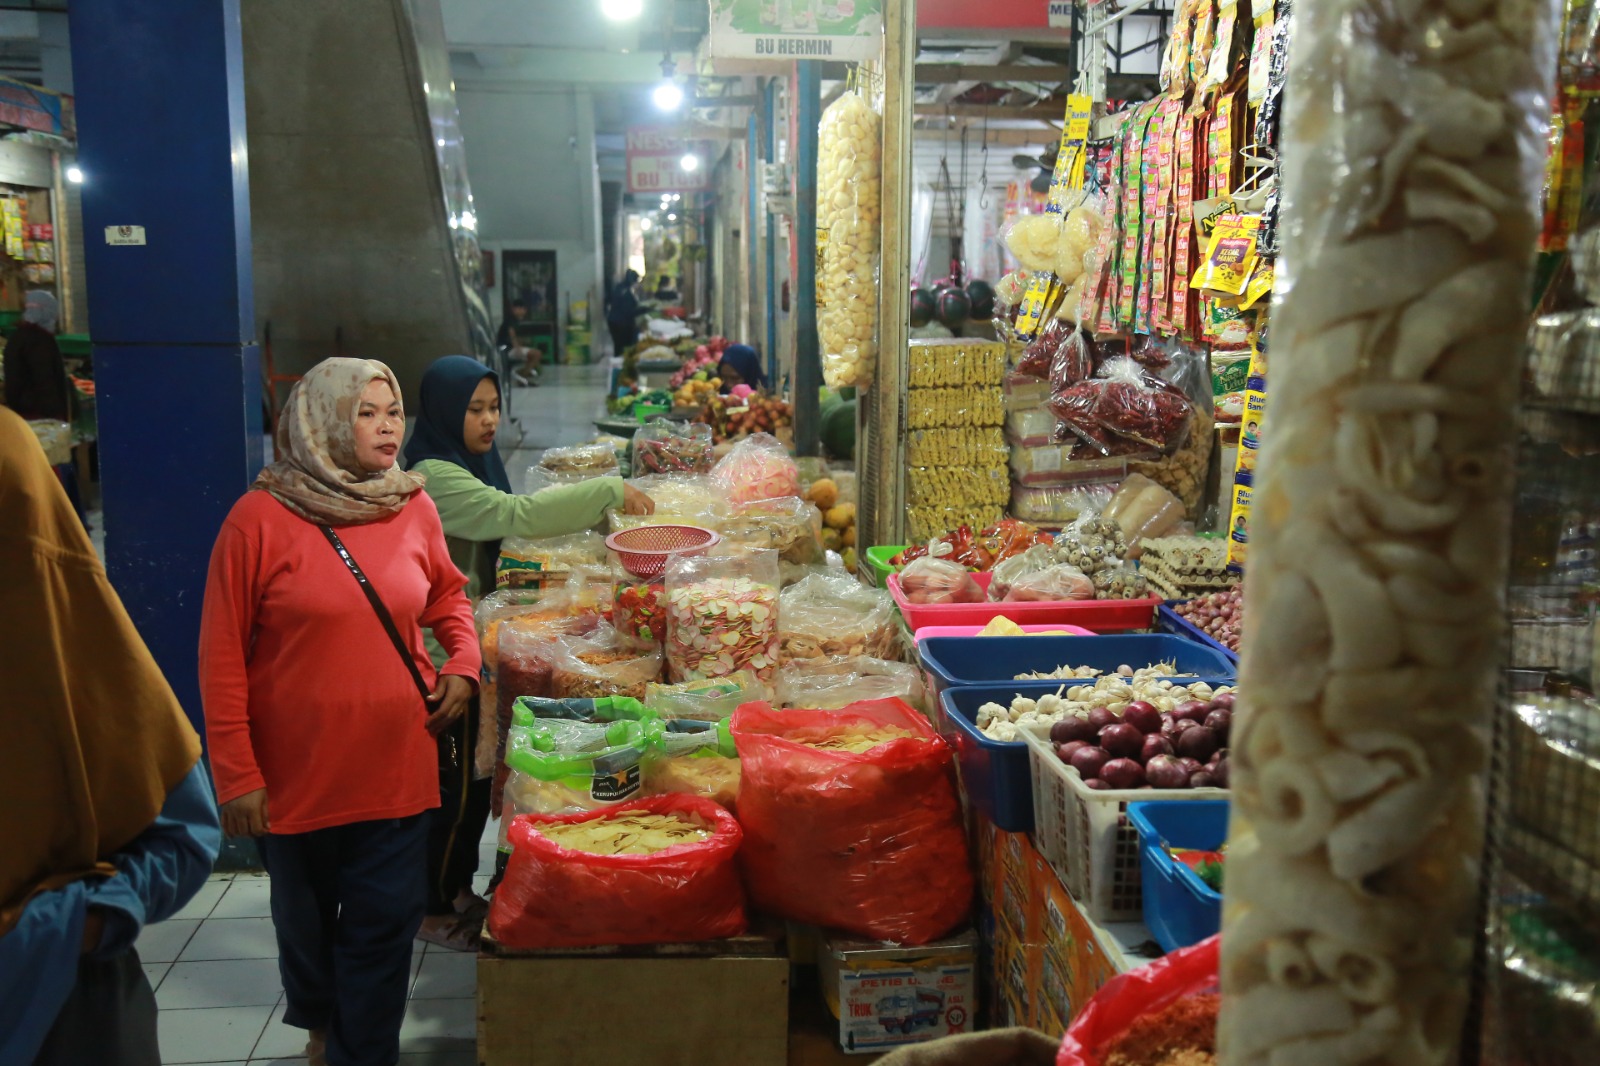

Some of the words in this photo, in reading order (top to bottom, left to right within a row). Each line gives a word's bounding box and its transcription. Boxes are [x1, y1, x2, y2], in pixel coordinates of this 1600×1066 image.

[755, 38, 774, 55] BU
[778, 39, 833, 56] HERMIN
[637, 172, 659, 187] BU
[1247, 403, 1265, 412] Ban
[1236, 497, 1253, 506] Ban
[861, 977, 902, 988] PETIS
[848, 1003, 872, 1017] TRUK
